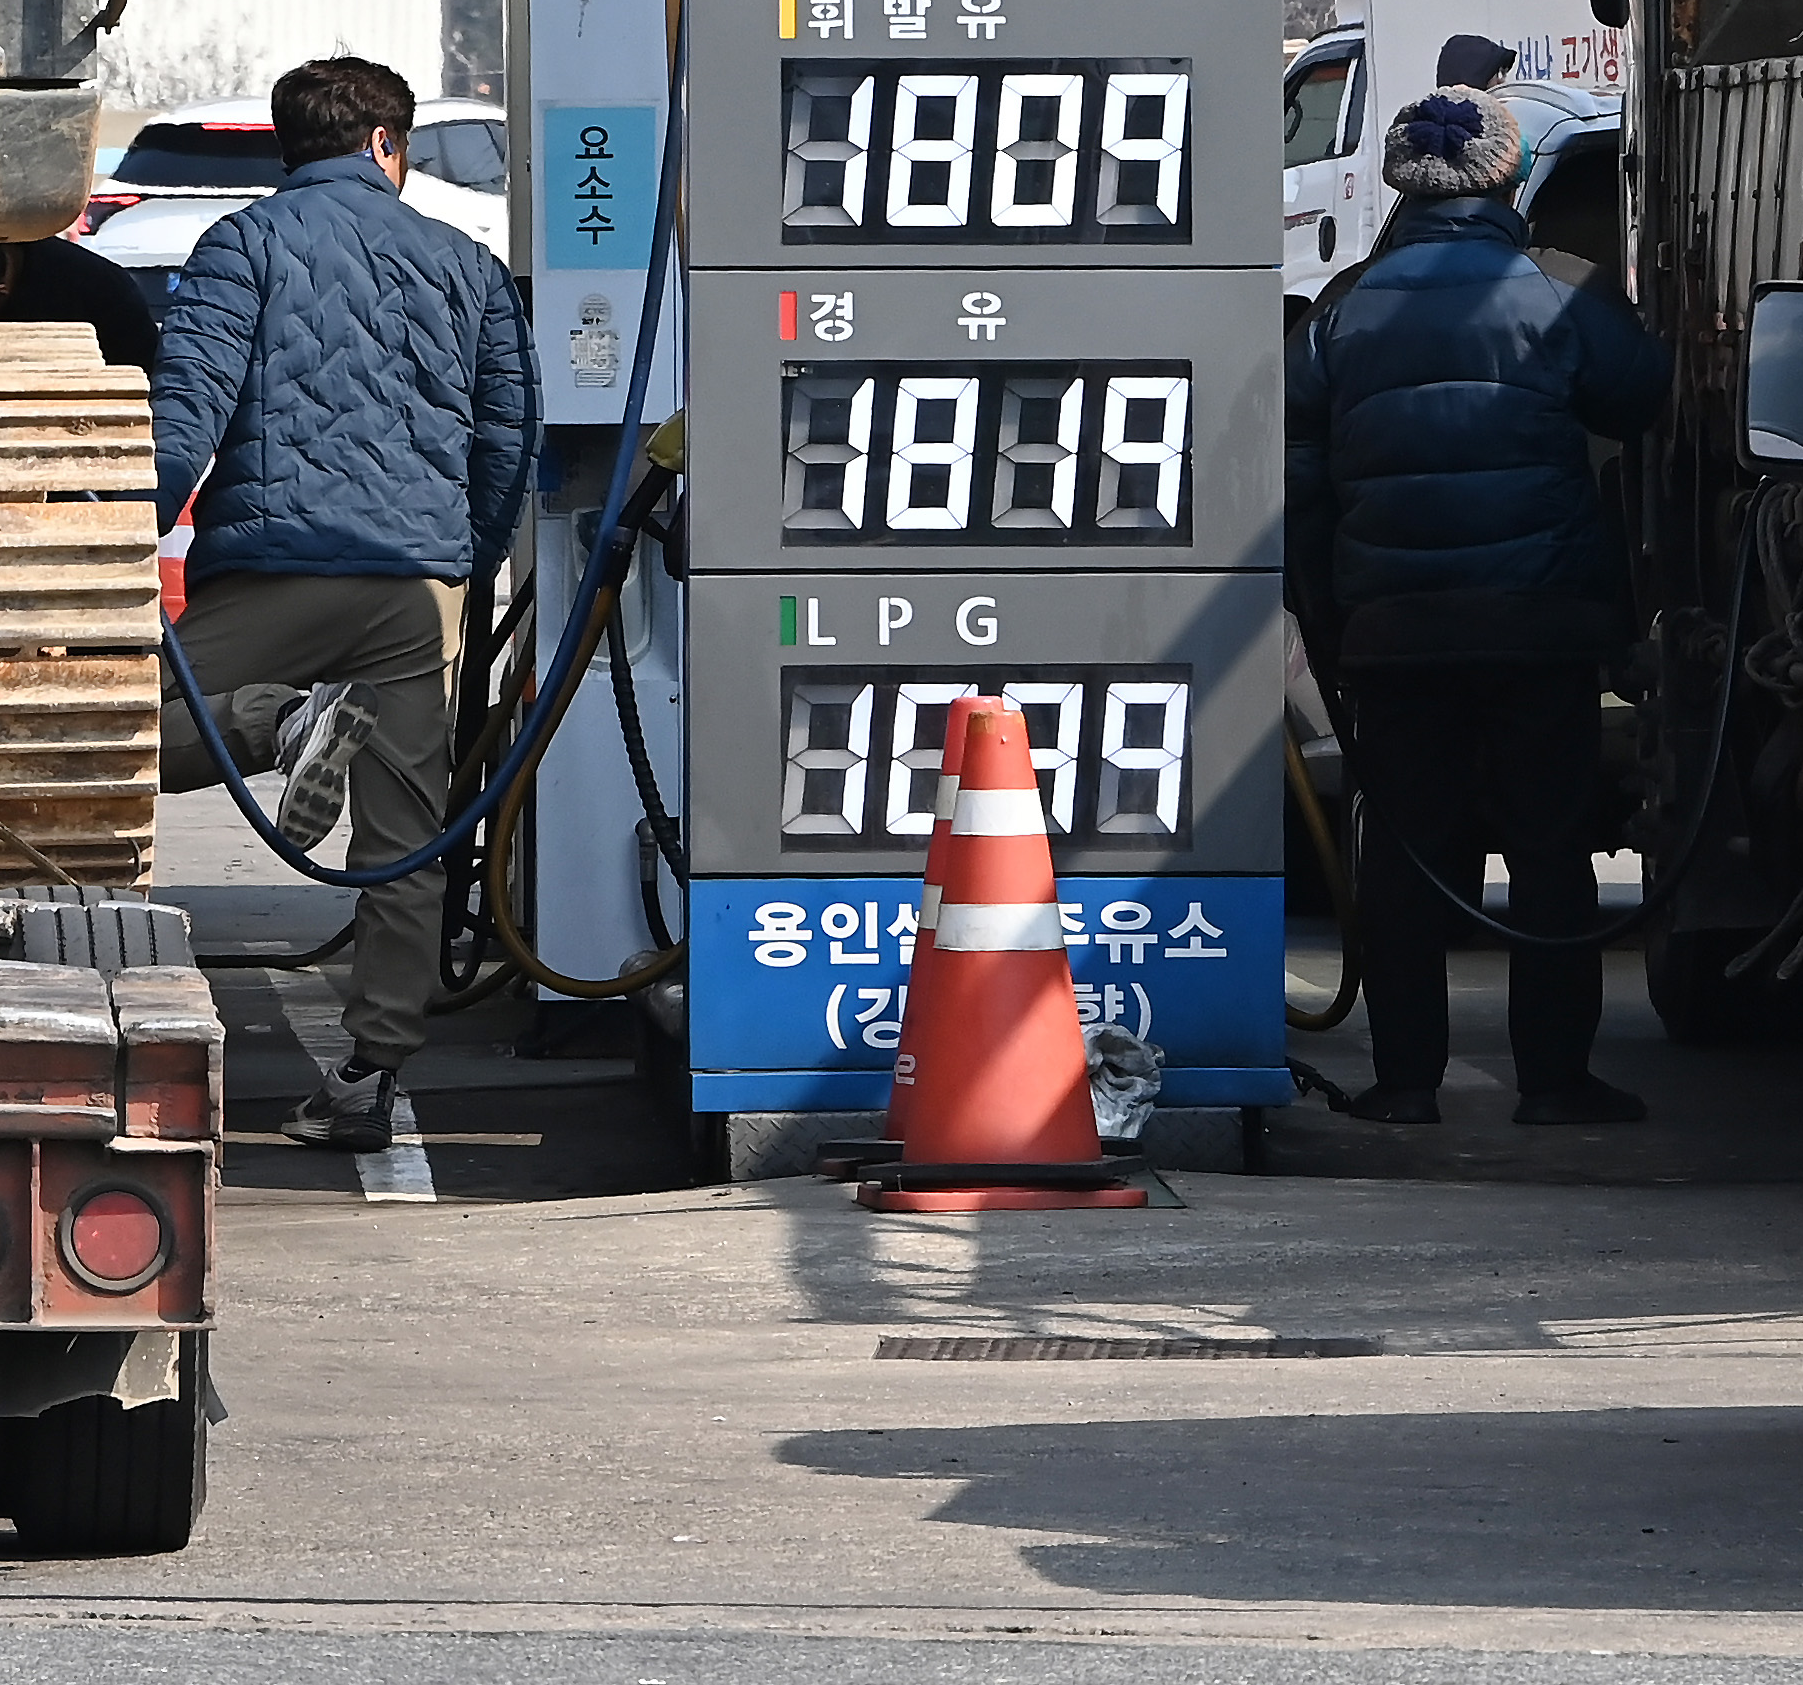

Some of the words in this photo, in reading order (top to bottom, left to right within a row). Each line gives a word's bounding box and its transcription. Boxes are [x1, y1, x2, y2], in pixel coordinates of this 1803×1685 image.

[1500, 34, 1554, 81] 서나
[1561, 28, 1625, 83] 고기생
[574, 125, 615, 246] 요소수
[840, 73, 1189, 227] 1809
[840, 377, 1189, 530] 1819
